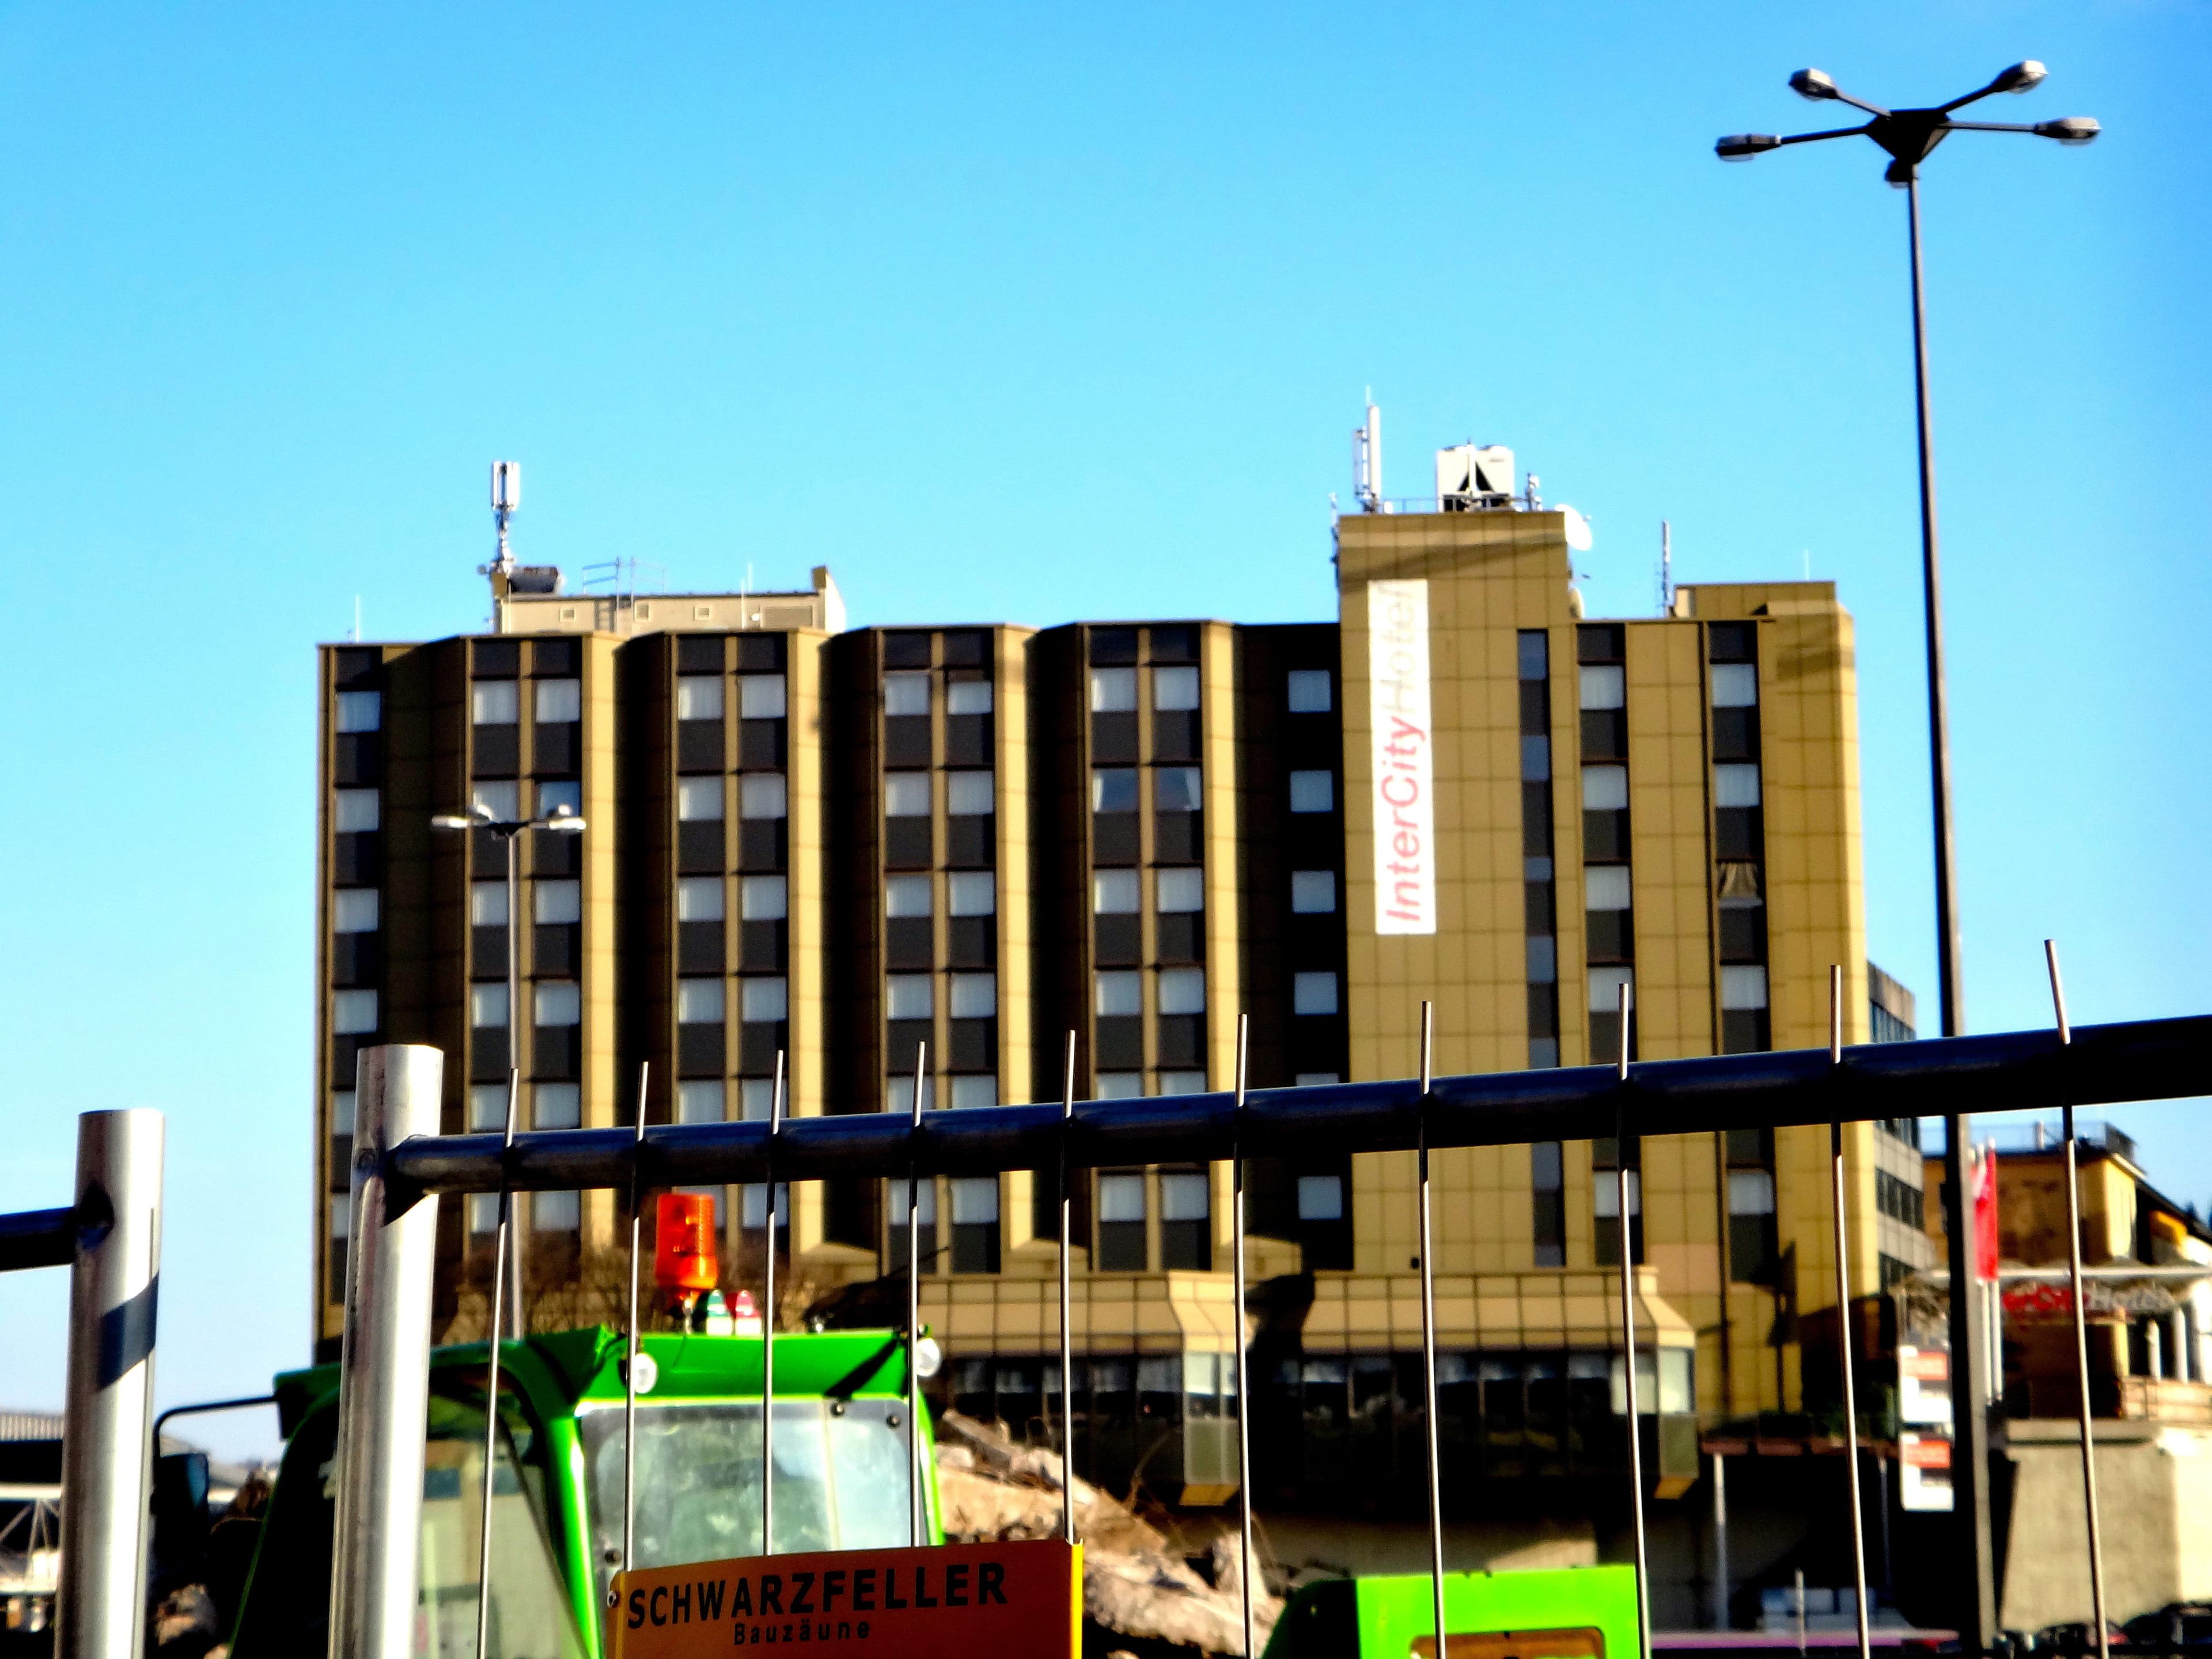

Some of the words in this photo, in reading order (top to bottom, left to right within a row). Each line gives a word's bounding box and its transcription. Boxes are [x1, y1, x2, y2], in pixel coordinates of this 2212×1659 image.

[1377, 582, 1426, 921] InterCityHotel
[628, 1563, 1007, 1629] SCHWARZFELLER
[734, 1619, 870, 1645] Bauzäune
